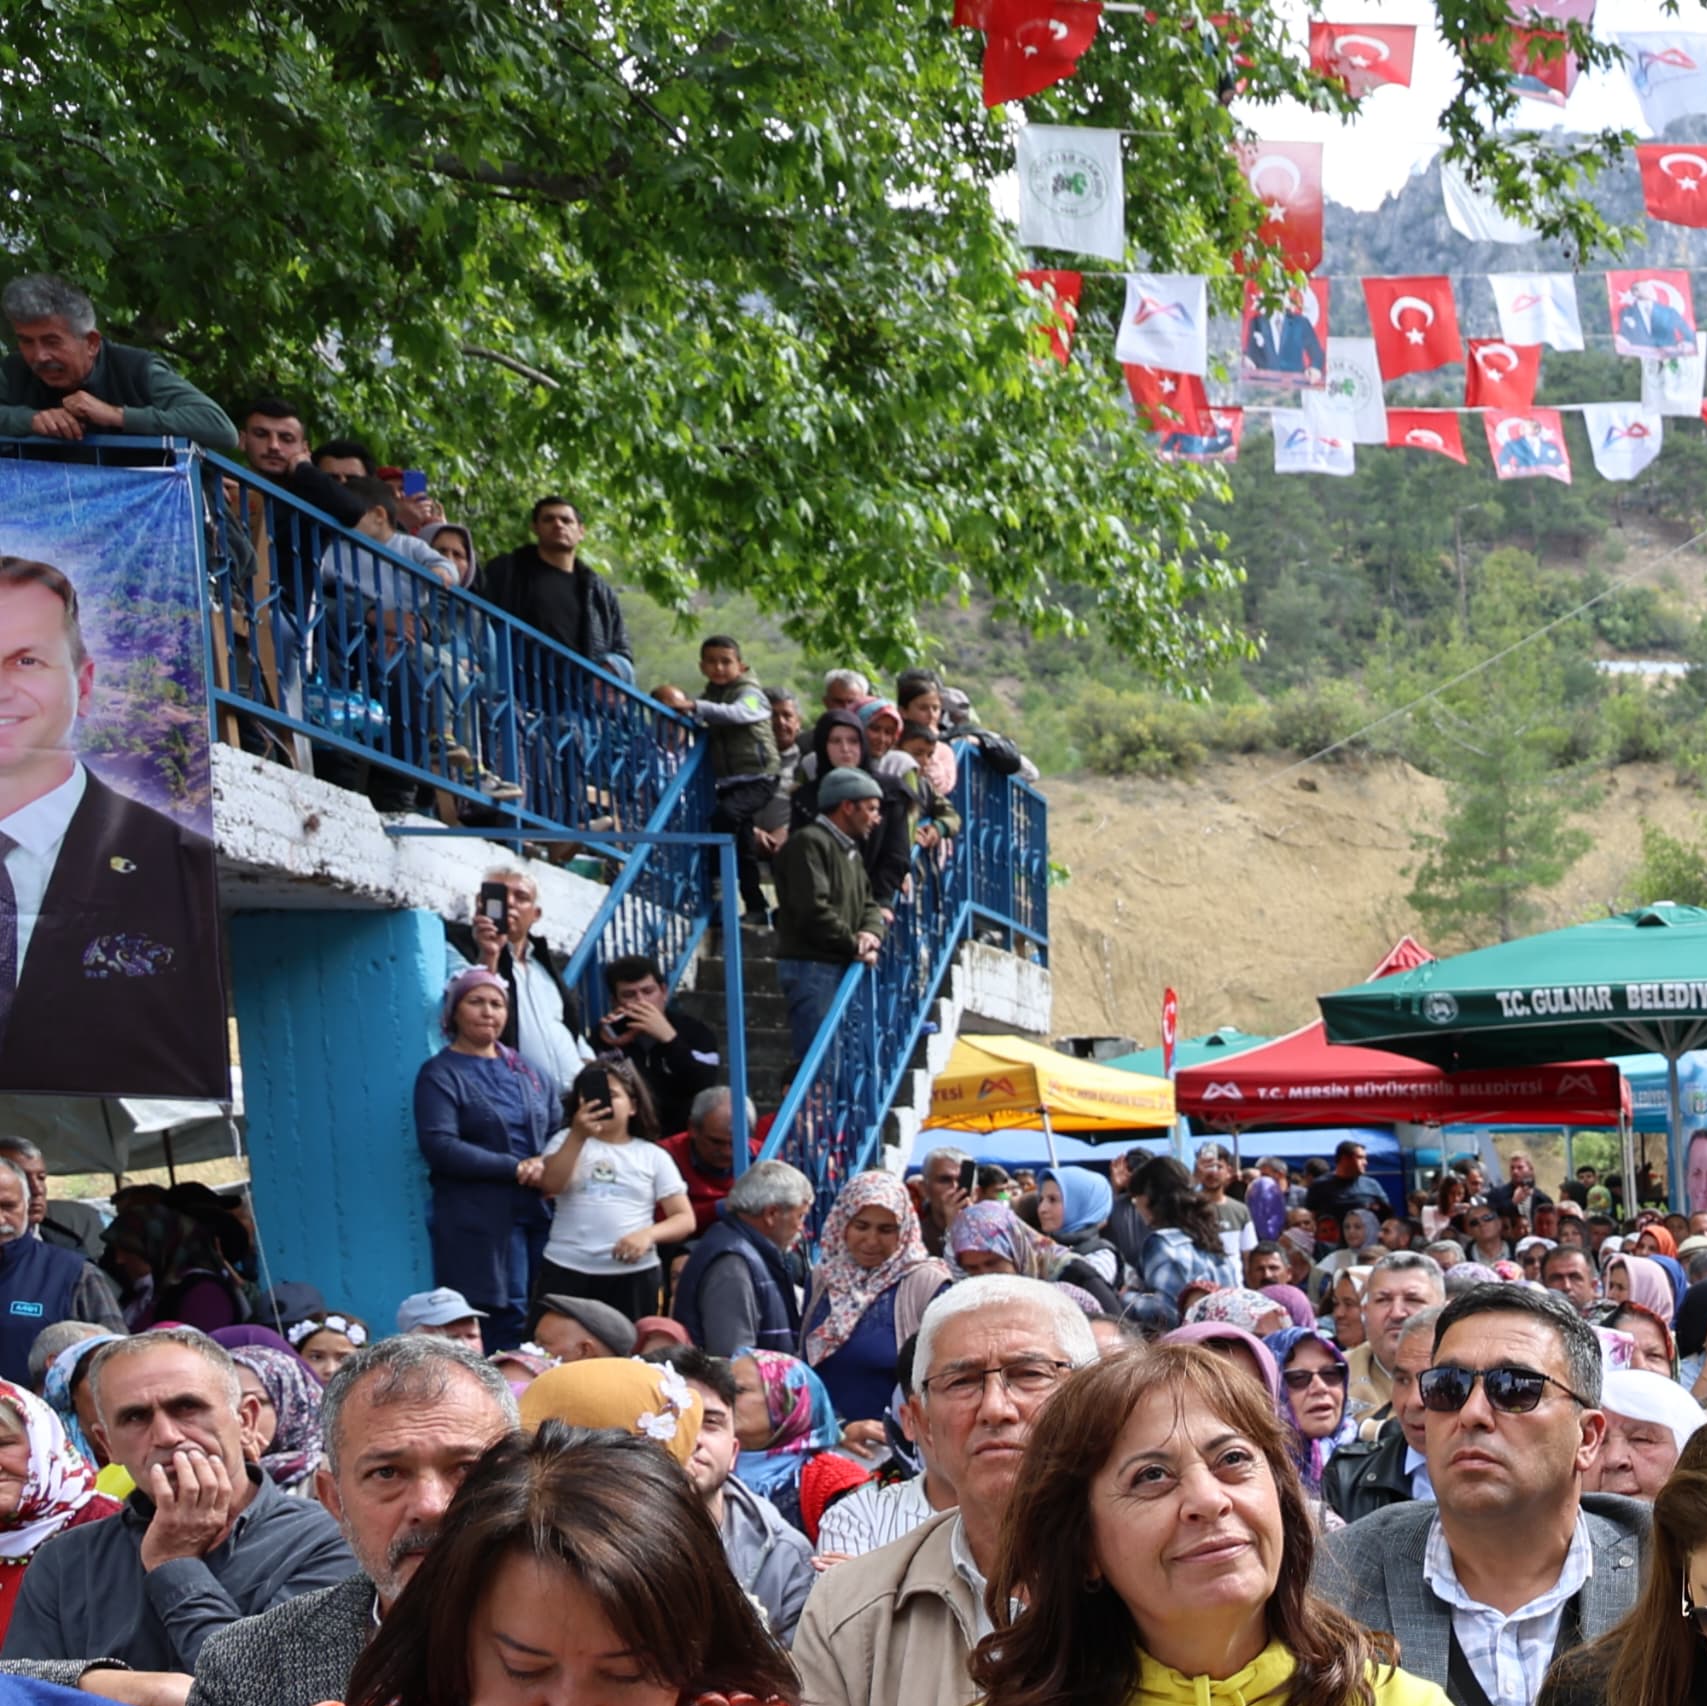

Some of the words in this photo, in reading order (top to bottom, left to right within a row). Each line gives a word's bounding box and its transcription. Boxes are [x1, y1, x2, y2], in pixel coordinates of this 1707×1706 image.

[1496, 990, 1530, 1018] T.C.
[1257, 1088, 1283, 1100] T.C.
[1289, 1083, 1349, 1099] MERSİN
[1353, 1080, 1452, 1099] BÜYÜKŞEHİR
[1460, 1078, 1543, 1096] BELEDİYESİ
